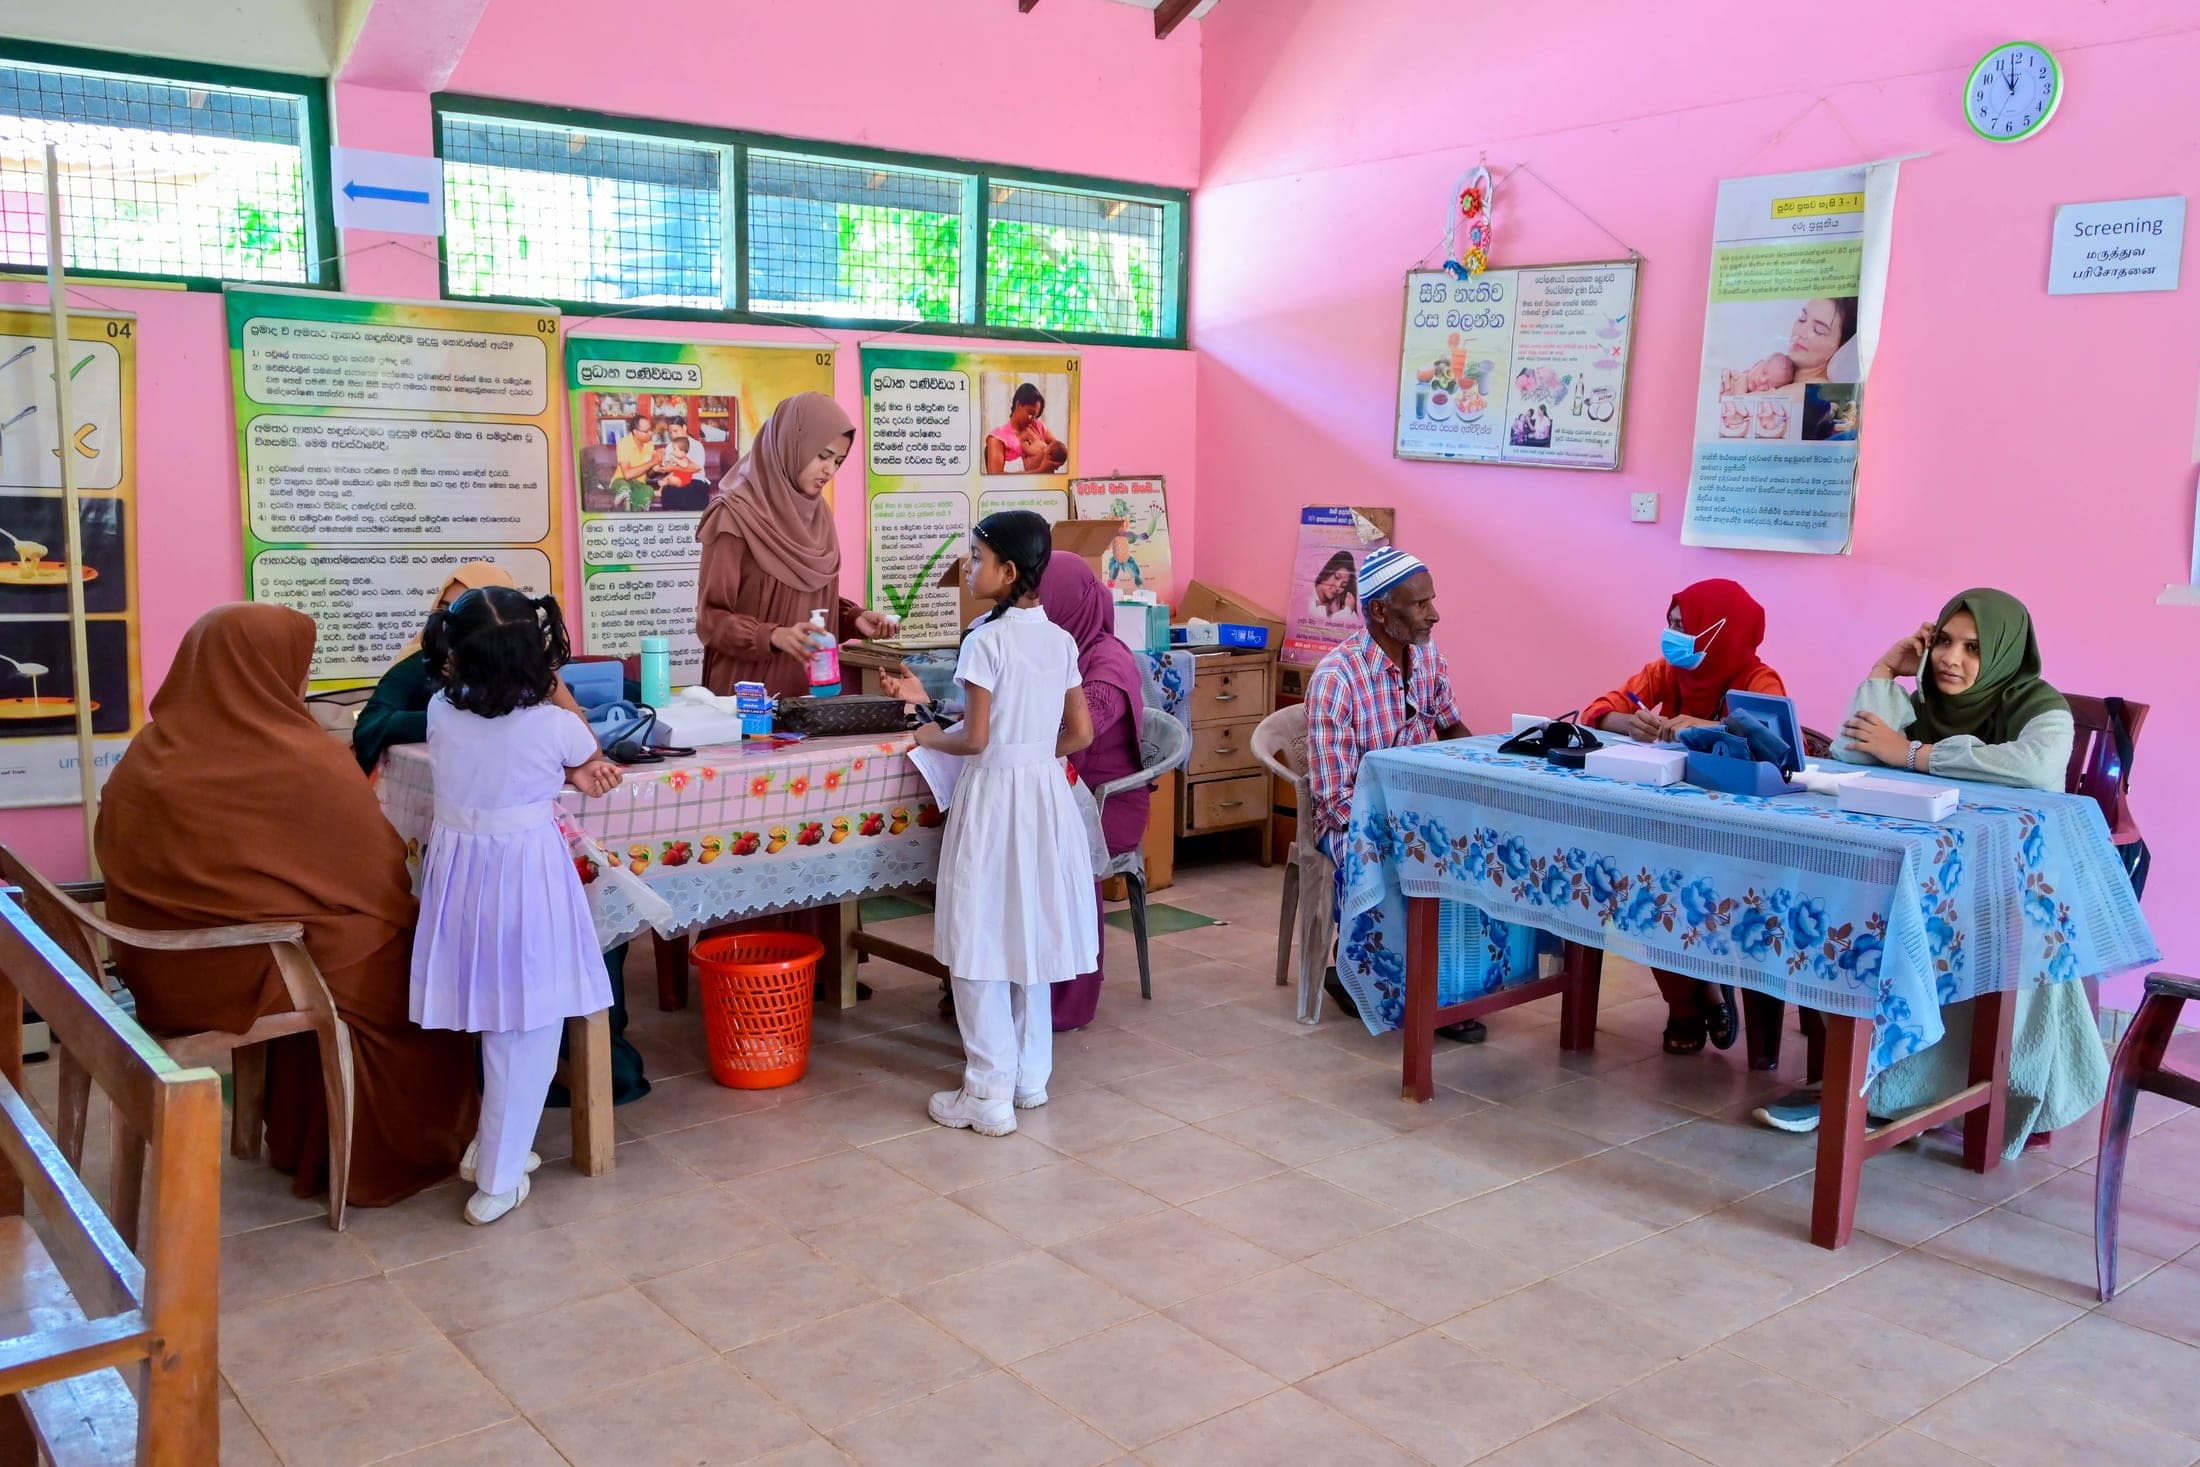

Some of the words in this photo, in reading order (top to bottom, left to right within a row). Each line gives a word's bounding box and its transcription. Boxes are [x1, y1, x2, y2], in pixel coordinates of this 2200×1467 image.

[1996, 59, 2004, 71] 11
[2029, 56, 2033, 67] 1
[2039, 67, 2046, 79] 2
[1983, 74, 1993, 86] 10
[2043, 83, 2051, 95] 3
[1977, 91, 1983, 102] 9
[1980, 107, 1987, 117] 8
[2035, 100, 2042, 112] 4
[1991, 118, 1998, 130] 7
[2006, 121, 2012, 132] 6
[2023, 115, 2030, 127] 5
[2074, 217, 2163, 237] Screening
[2086, 247, 2145, 261] மருத்துவ
[2073, 265, 2156, 280] பரிசோதனை
[1419, 283, 1447, 303] සීනි
[1454, 282, 1504, 303] නැතිව
[537, 319, 555, 333] 03
[1414, 312, 1439, 328] රස
[1447, 308, 1504, 332] බලන්න
[107, 322, 131, 338] 04
[815, 353, 831, 366] 02
[1066, 360, 1079, 371] 01
[581, 366, 620, 381] ප්‍රධාන
[688, 369, 697, 381] 2
[874, 376, 904, 391] ප්‍රධාන
[959, 380, 965, 390] 1
[906, 403, 911, 411] 6
[476, 432, 482, 440] 6
[59, 752, 111, 769] unef
